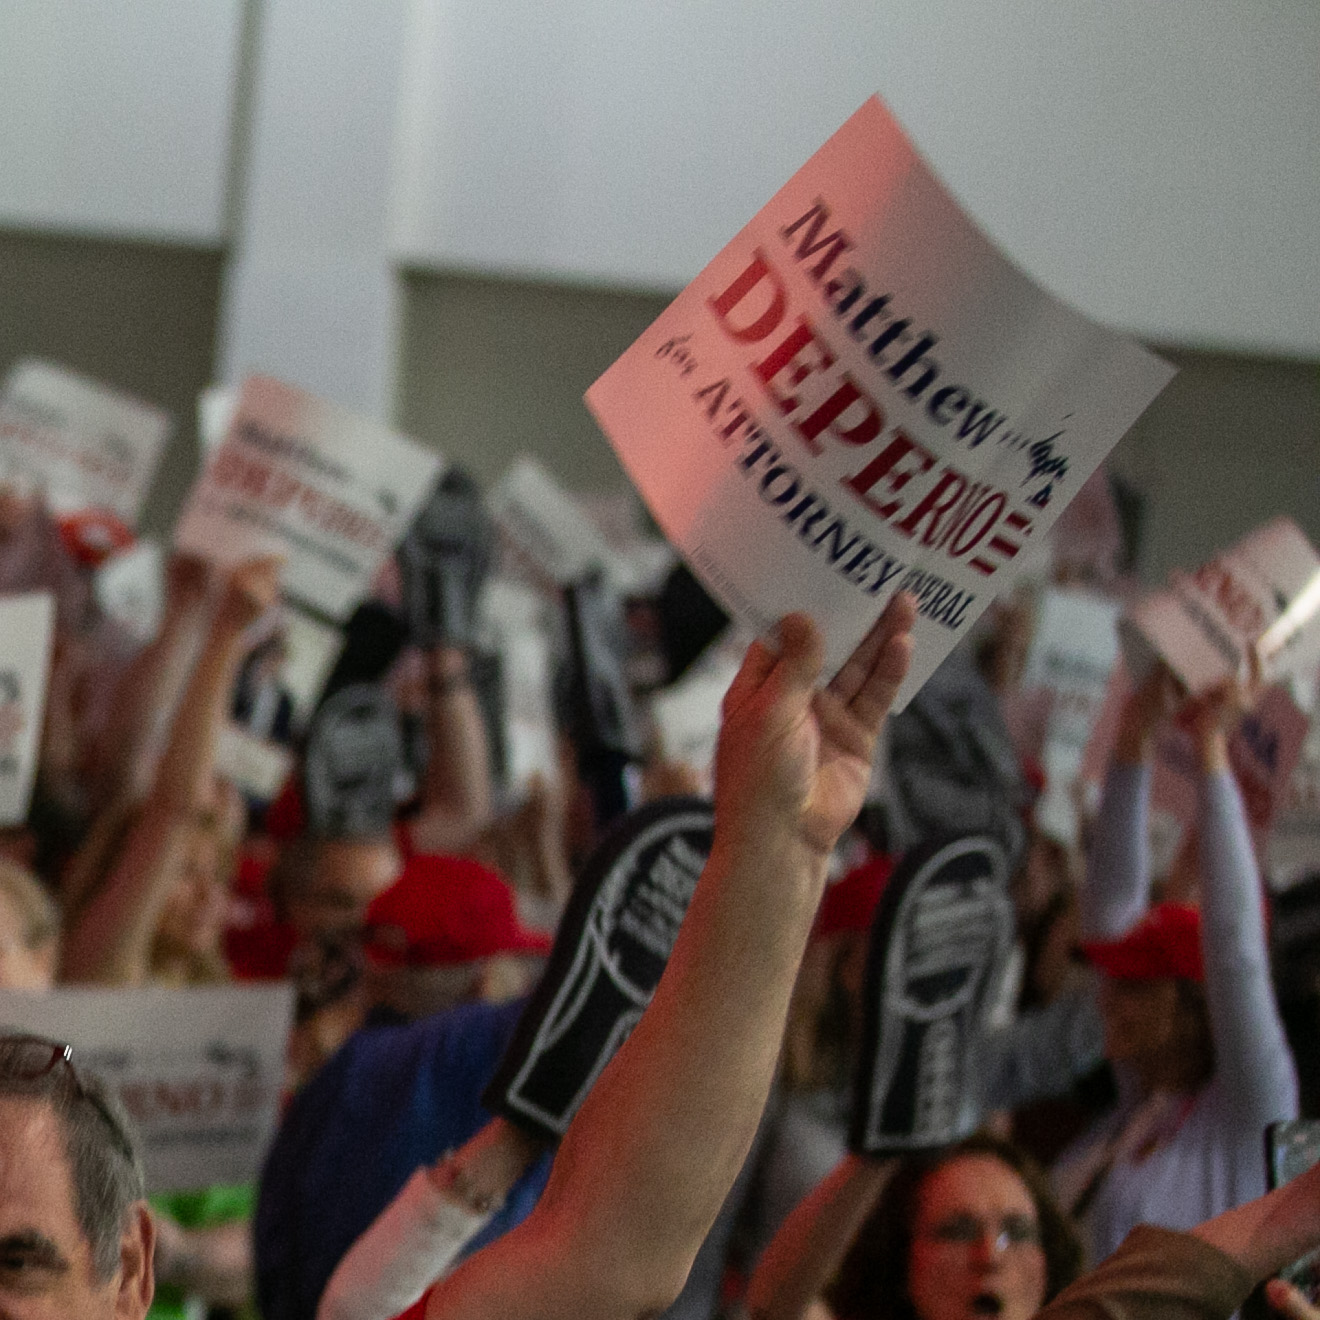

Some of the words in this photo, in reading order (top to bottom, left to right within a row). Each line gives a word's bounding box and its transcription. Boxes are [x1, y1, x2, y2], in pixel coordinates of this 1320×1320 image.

[706, 245, 1010, 558] DEPERNO
[781, 195, 1008, 451] Matthew
[694, 376, 909, 596] ATTORNEY
